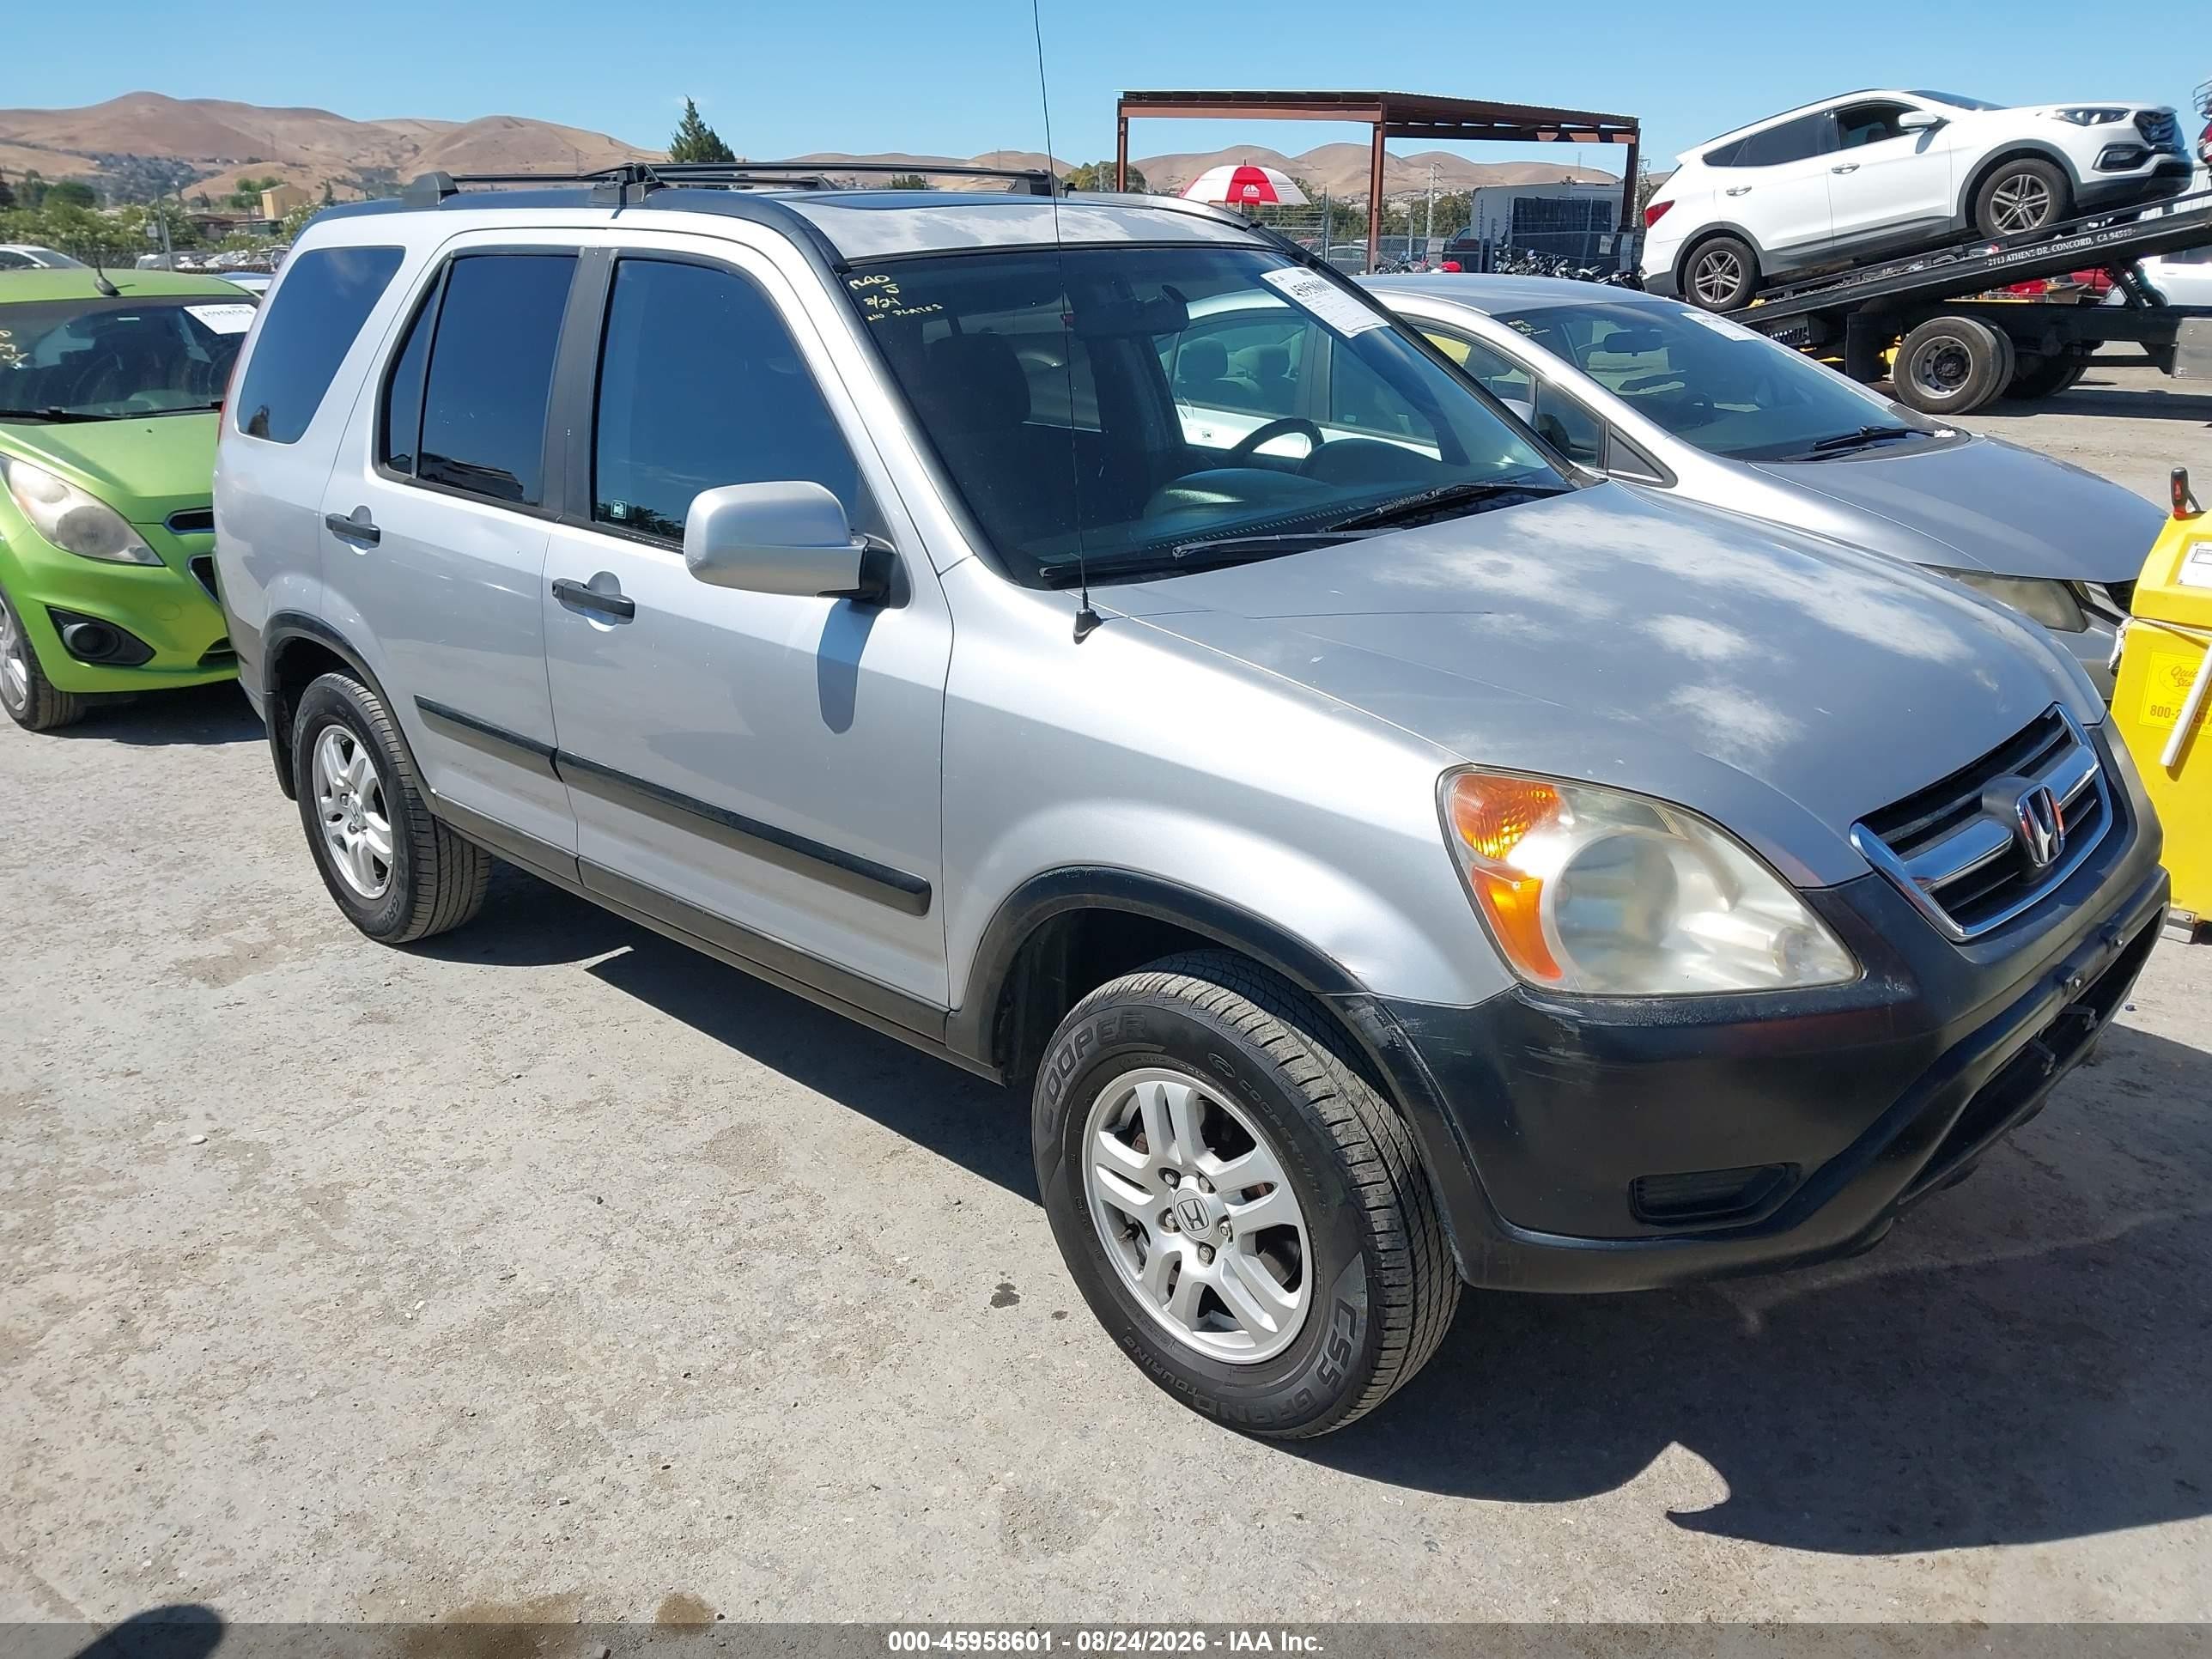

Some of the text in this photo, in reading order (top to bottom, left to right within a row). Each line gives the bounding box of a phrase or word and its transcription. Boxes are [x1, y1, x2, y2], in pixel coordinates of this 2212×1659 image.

[2051, 237, 2094, 253] CONCORD,
[2097, 234, 2108, 242] CA
[1041, 1012, 1147, 1134] COOPER
[1122, 1334, 1201, 1397] TOURING
[1315, 1297, 1358, 1392] CS5
